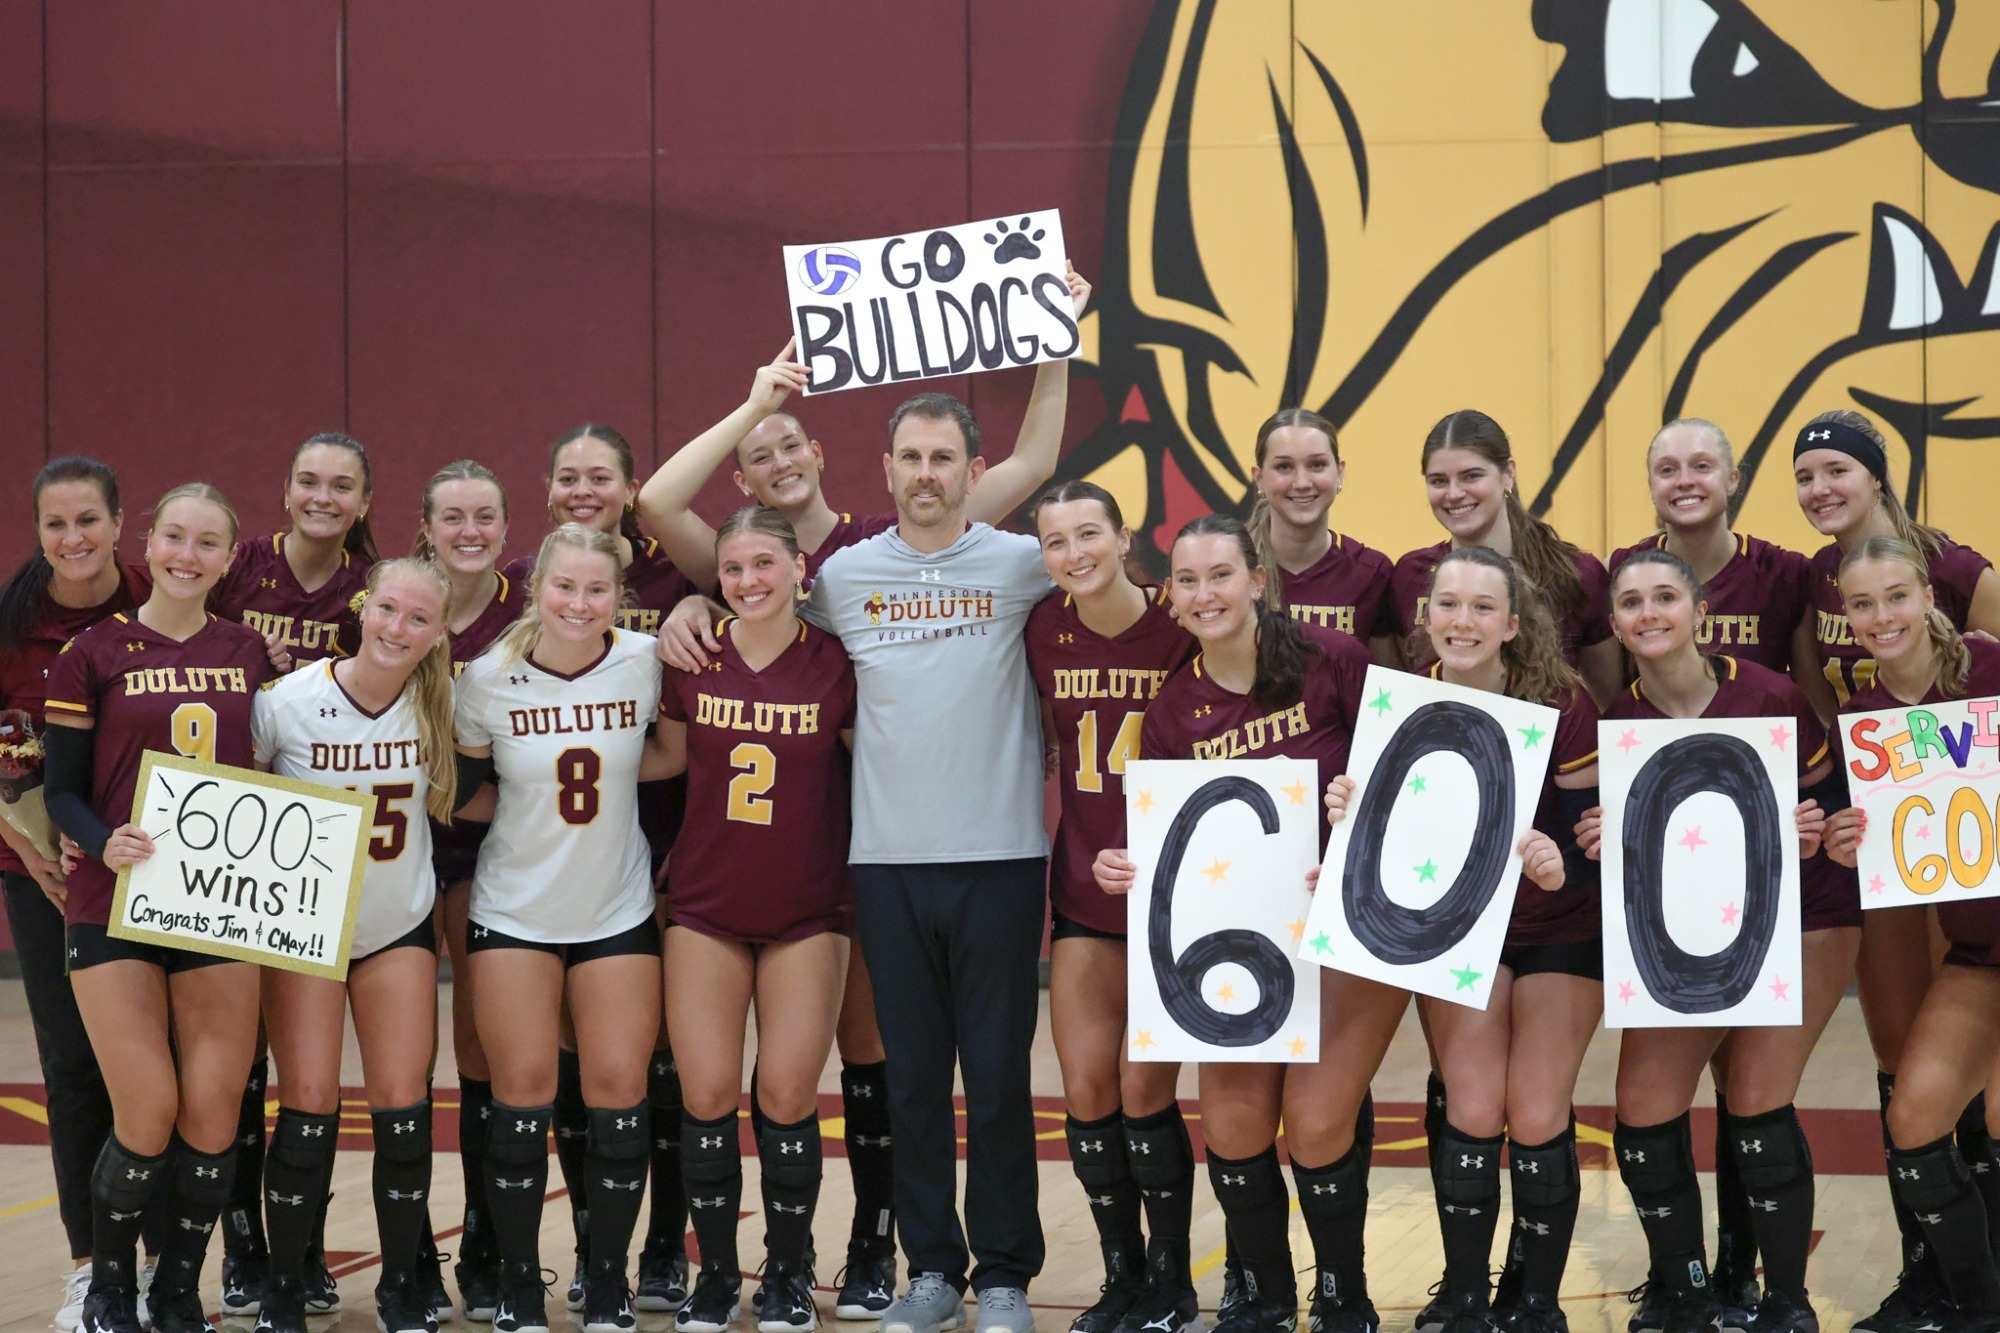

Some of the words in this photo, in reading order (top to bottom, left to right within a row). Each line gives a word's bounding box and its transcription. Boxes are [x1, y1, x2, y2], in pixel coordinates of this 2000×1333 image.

[881, 230, 965, 289] GO
[796, 272, 1080, 393] BULLDOGS
[888, 589, 993, 602] MINNESOTA
[889, 599, 993, 622] DULUTH
[242, 609, 339, 651] DULUT
[878, 626, 988, 641] VOLLEYBALL
[1695, 615, 1760, 645] UTH
[124, 667, 248, 696] DULUTH
[1053, 669, 1168, 699] DULUTH
[171, 702, 217, 764] 9
[509, 700, 638, 736] DULUTH
[695, 693, 820, 735] DULUTH
[1850, 700, 2000, 783] SERVI
[1075, 710, 1145, 795] 14
[556, 745, 603, 827] 8
[726, 742, 777, 825] 2
[177, 781, 312, 871] 600
[344, 781, 415, 863] 5
[1892, 787, 2000, 895] 60
[130, 894, 210, 932] Congrats
[212, 914, 248, 942] Jim
[1148, 775, 1295, 1047] 6
